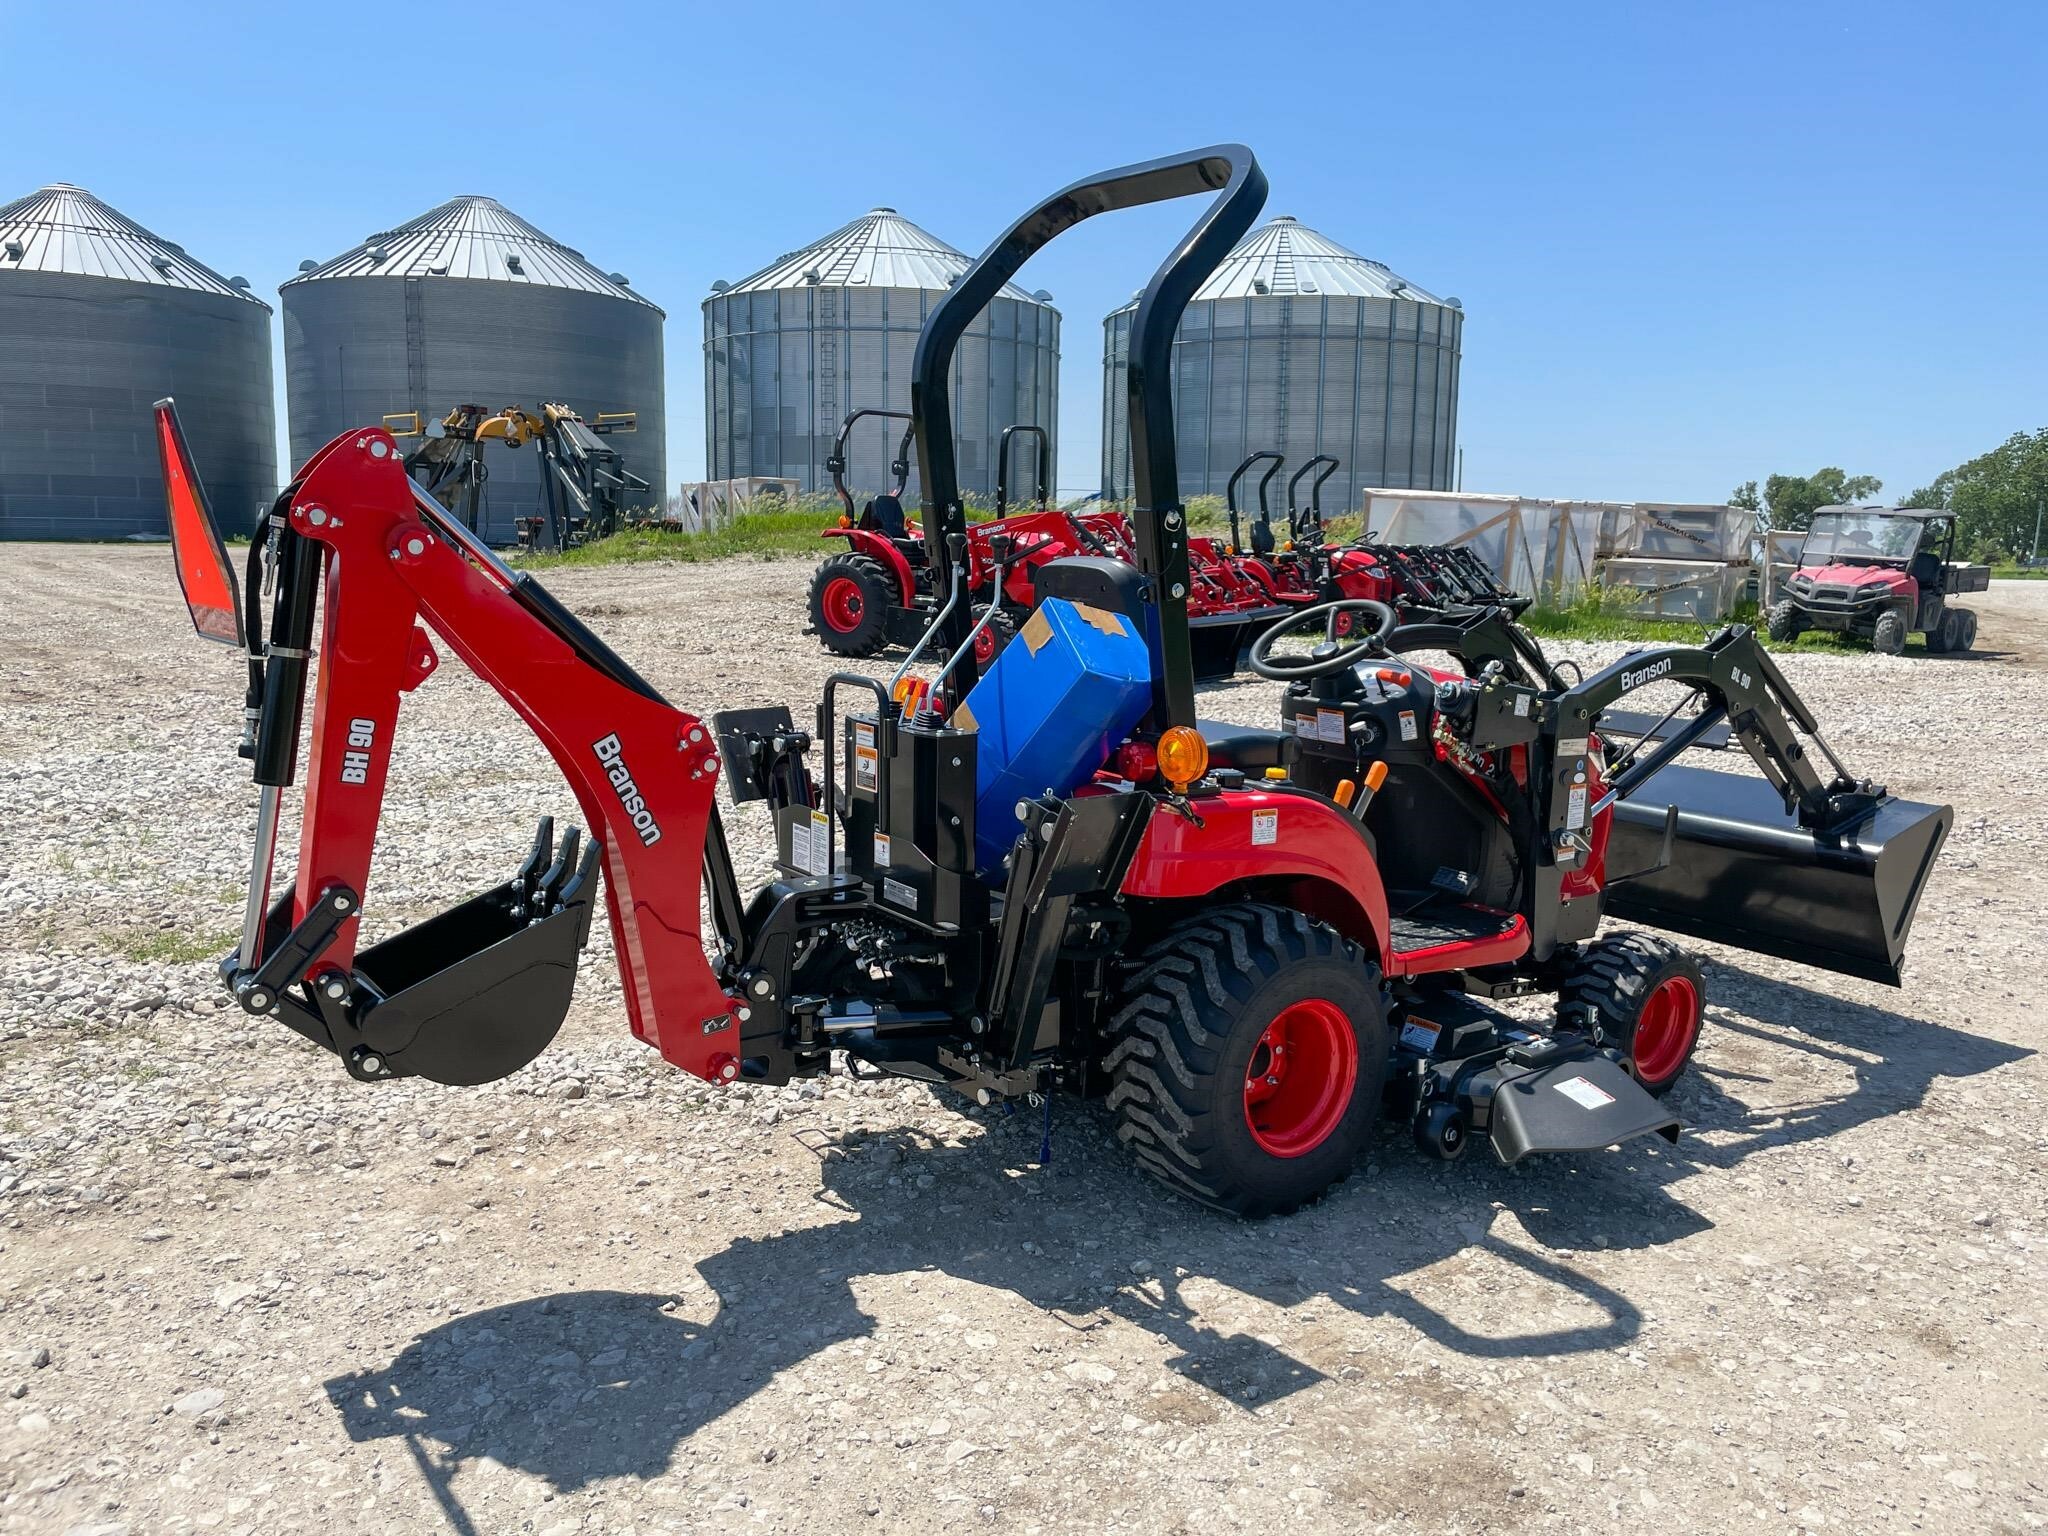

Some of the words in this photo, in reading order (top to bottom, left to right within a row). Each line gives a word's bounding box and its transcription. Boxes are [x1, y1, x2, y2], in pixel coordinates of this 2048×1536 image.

[976, 524, 1006, 537] Branson
[1620, 657, 1672, 692] Branson
[1730, 666, 1741, 684] BL
[1740, 675, 1751, 690] 90
[347, 718, 375, 748] 90
[341, 751, 370, 784] BH
[592, 733, 662, 847] Branson
